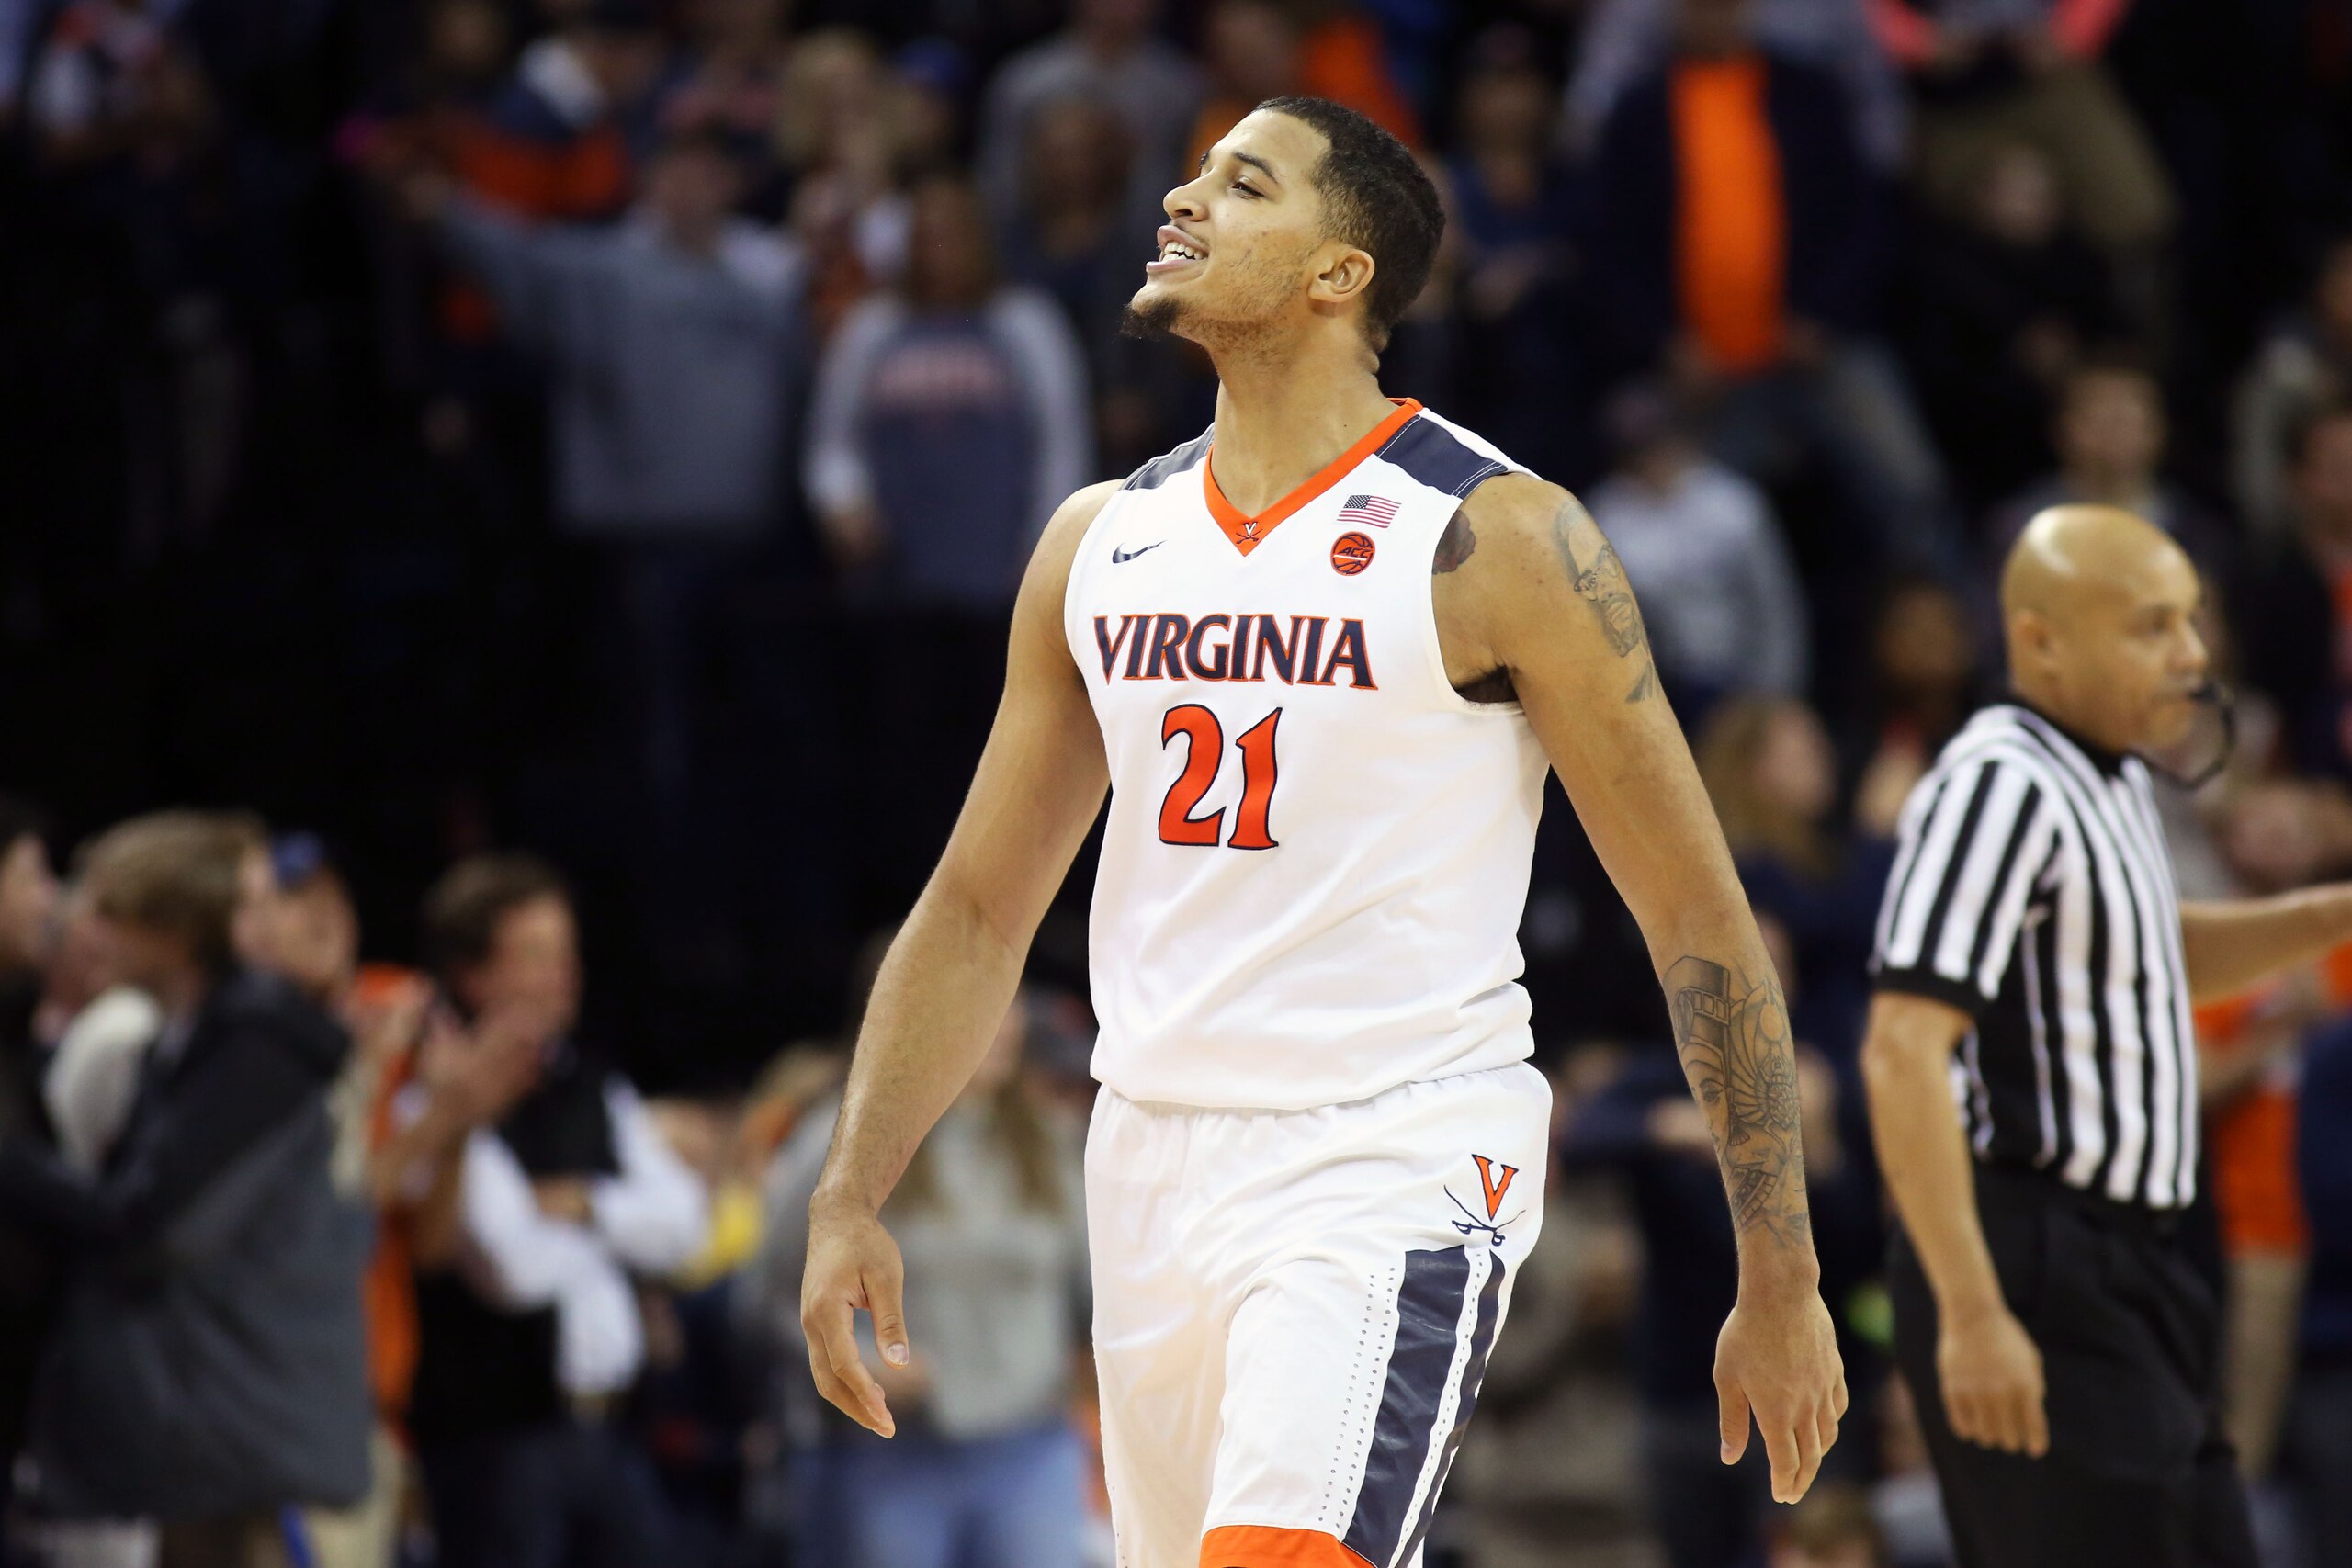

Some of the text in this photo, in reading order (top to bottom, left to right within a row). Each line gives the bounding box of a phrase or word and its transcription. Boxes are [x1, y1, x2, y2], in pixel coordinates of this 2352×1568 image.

[1242, 521, 1258, 536] V
[1338, 547, 1373, 559] ACC
[1093, 613, 1378, 691] VIRGINIA
[1158, 704, 1283, 850] 21
[1471, 1154, 1519, 1222] V
